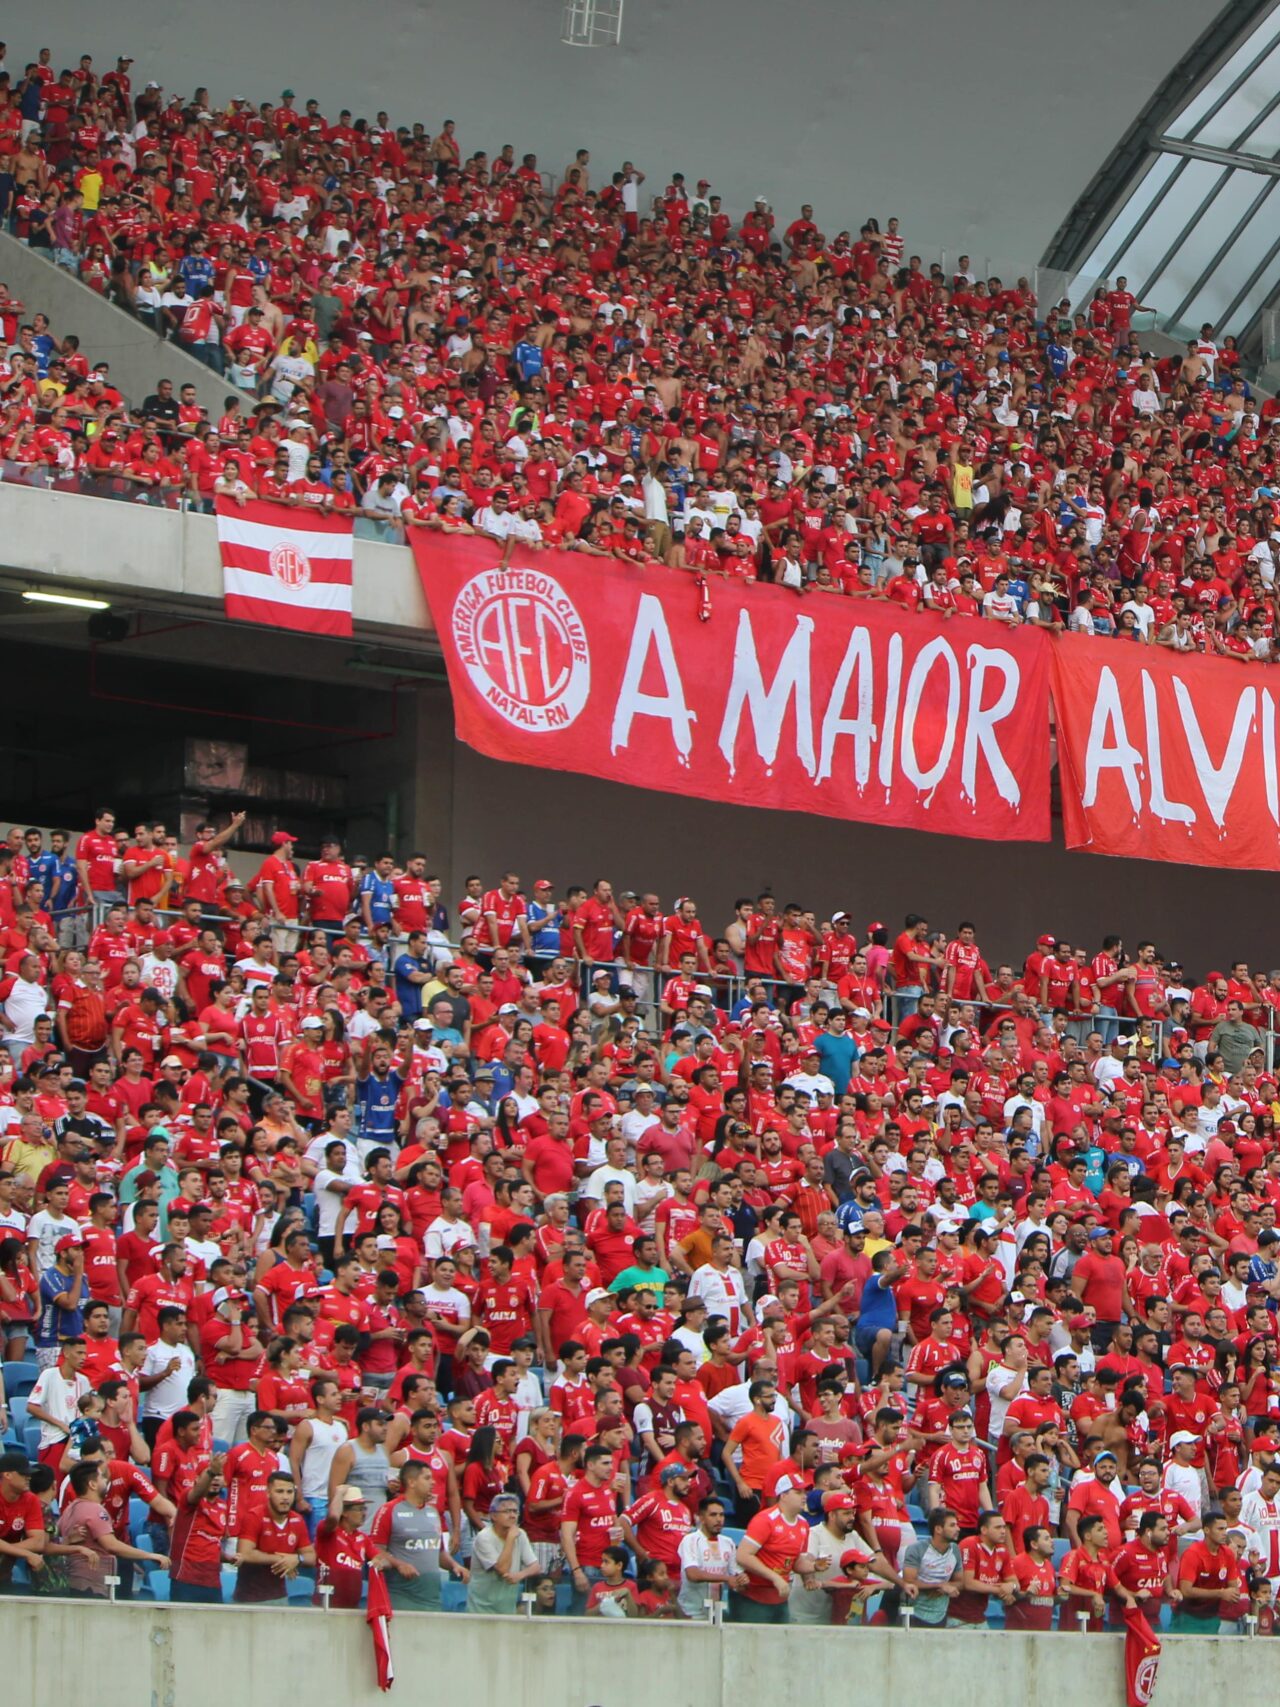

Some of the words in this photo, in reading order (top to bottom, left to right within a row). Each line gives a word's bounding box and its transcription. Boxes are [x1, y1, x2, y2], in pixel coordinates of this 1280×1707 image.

[486, 571, 554, 600] FUTEBOL
[556, 599, 587, 665] CLUBE
[477, 597, 570, 701] AFC
[611, 592, 698, 766] A
[718, 608, 1021, 812] MAIOR
[489, 1311, 517, 1321] CAIXA
[949, 1459, 961, 1471] 10
[660, 1509, 672, 1522] 10
